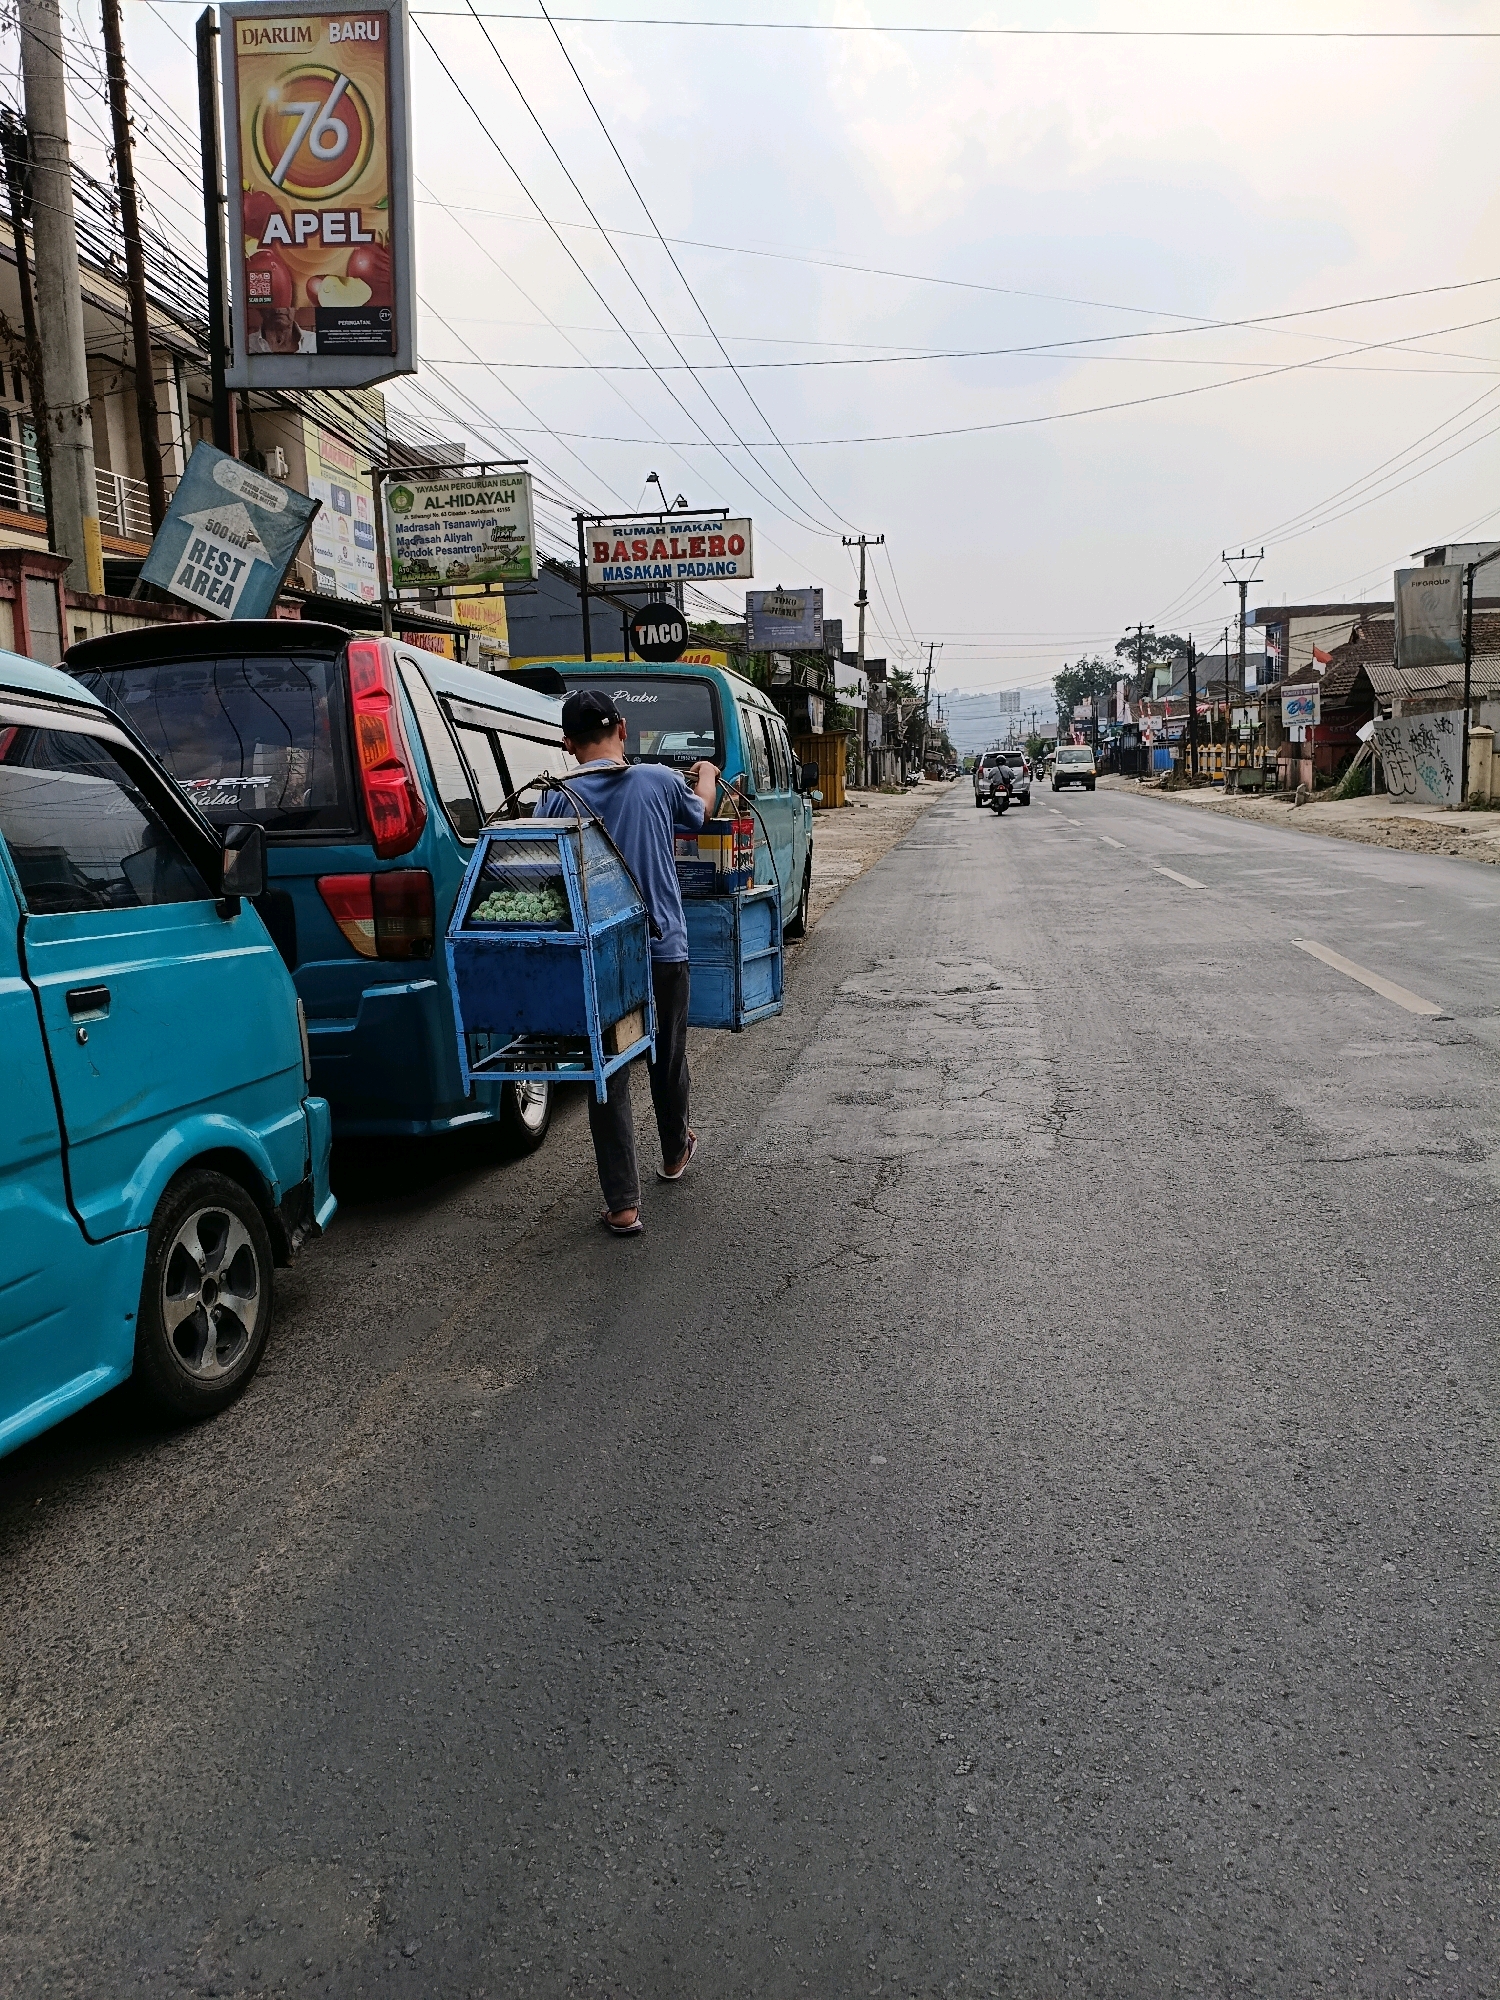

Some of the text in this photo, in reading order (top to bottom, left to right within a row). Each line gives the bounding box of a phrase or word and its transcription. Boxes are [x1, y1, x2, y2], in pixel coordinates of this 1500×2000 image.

[242, 26, 312, 46] DJARUM
[328, 20, 380, 44] BARU
[271, 73, 350, 188] 76
[262, 212, 373, 244] APEL
[415, 485, 449, 494] YAYASAN
[451, 480, 498, 490] PERGURUAN
[424, 490, 515, 510] AL-HIDAYAH
[205, 518, 228, 539] 500
[396, 517, 497, 533] Madrasah Tsanawiyah
[613, 522, 723, 537] RUMAH MAKAN
[396, 532, 472, 546] Madrasah Aliyah
[592, 534, 745, 564] BASALERO
[188, 538, 246, 583] REST
[398, 545, 482, 558] Pondok Pesantren
[603, 561, 737, 582] MASAKAN PADANG
[177, 564, 235, 609] AREA
[635, 622, 683, 645] TACO
